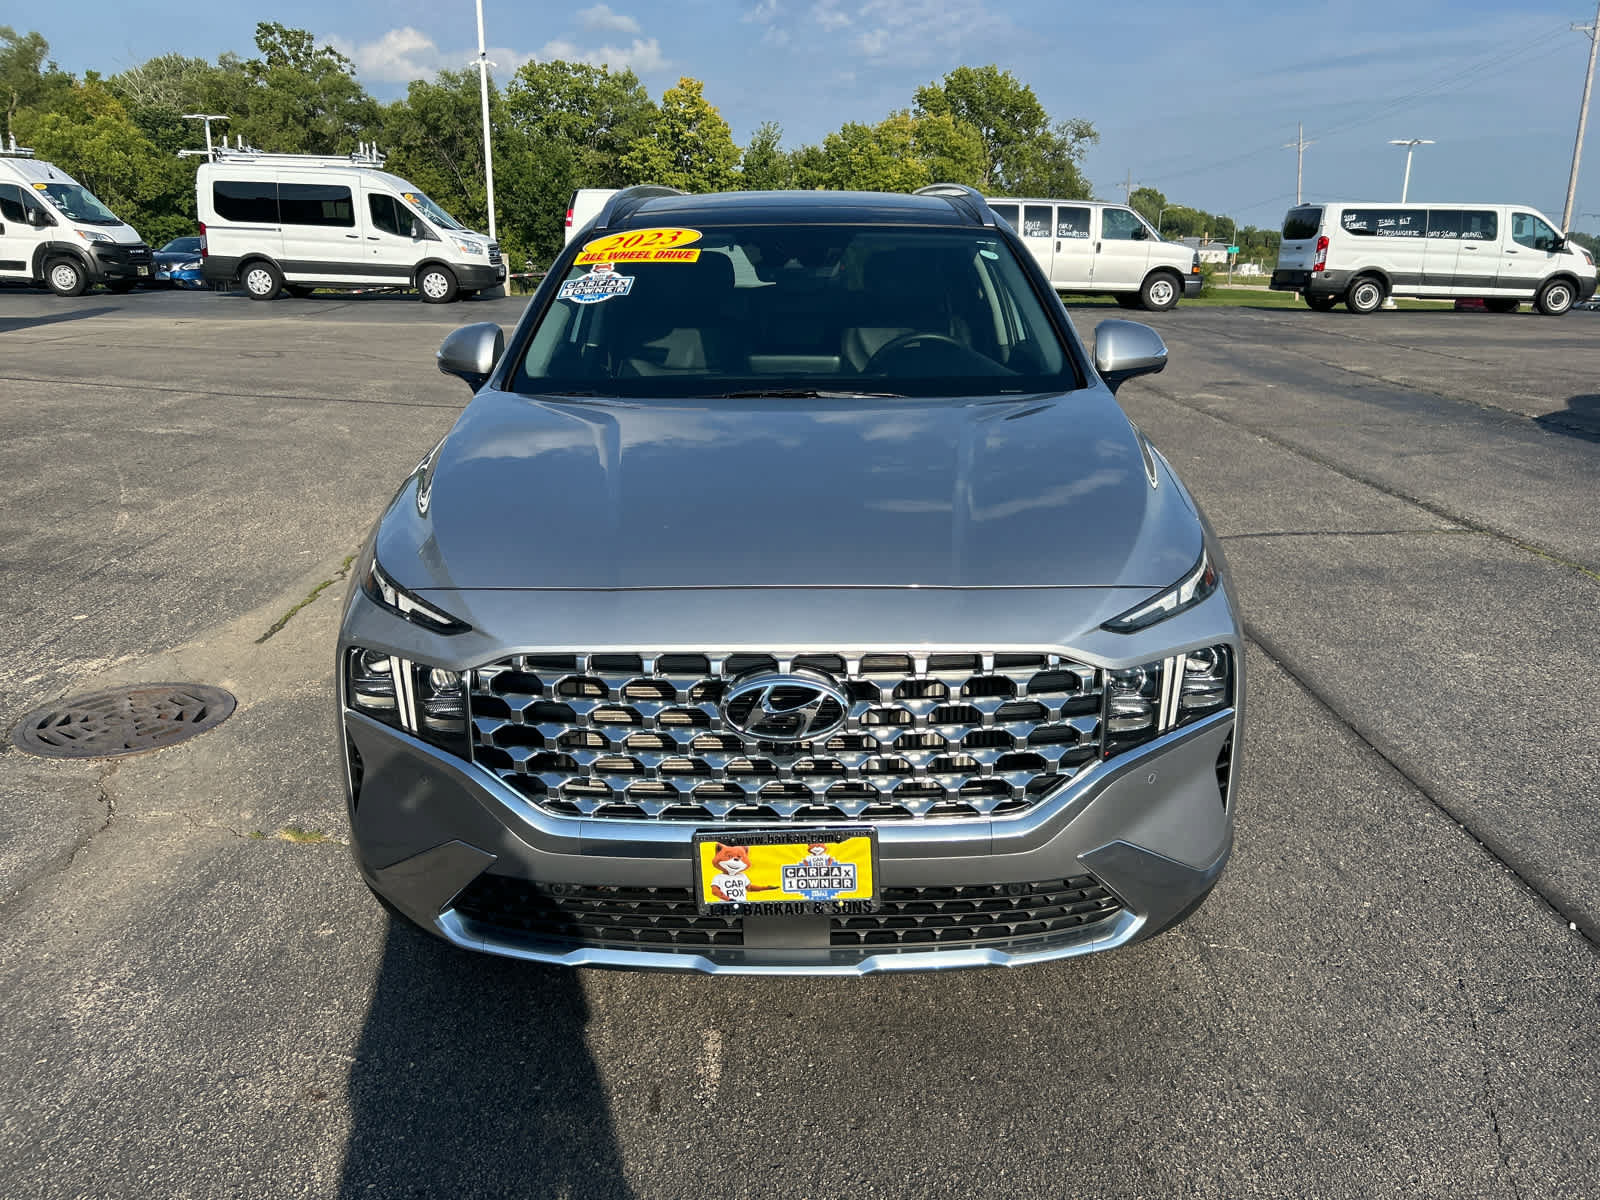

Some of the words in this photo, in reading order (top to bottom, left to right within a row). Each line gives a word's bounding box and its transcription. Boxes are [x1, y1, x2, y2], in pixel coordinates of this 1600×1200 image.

[603, 230, 683, 251] 2023
[579, 253, 604, 262] ALL
[607, 251, 651, 260] WHEEL
[654, 249, 695, 259] DRIVE
[565, 279, 627, 289] CARFAX
[573, 286, 626, 296] OWNER
[736, 833, 836, 845] www.barkau.com
[785, 867, 852, 878] CARFAX
[724, 879, 744, 889] CAR
[797, 878, 852, 888] OWNER
[726, 889, 745, 898] FOX
[743, 902, 805, 916] BARKAU
[813, 902, 825, 914] &
[832, 899, 873, 914] SONS
